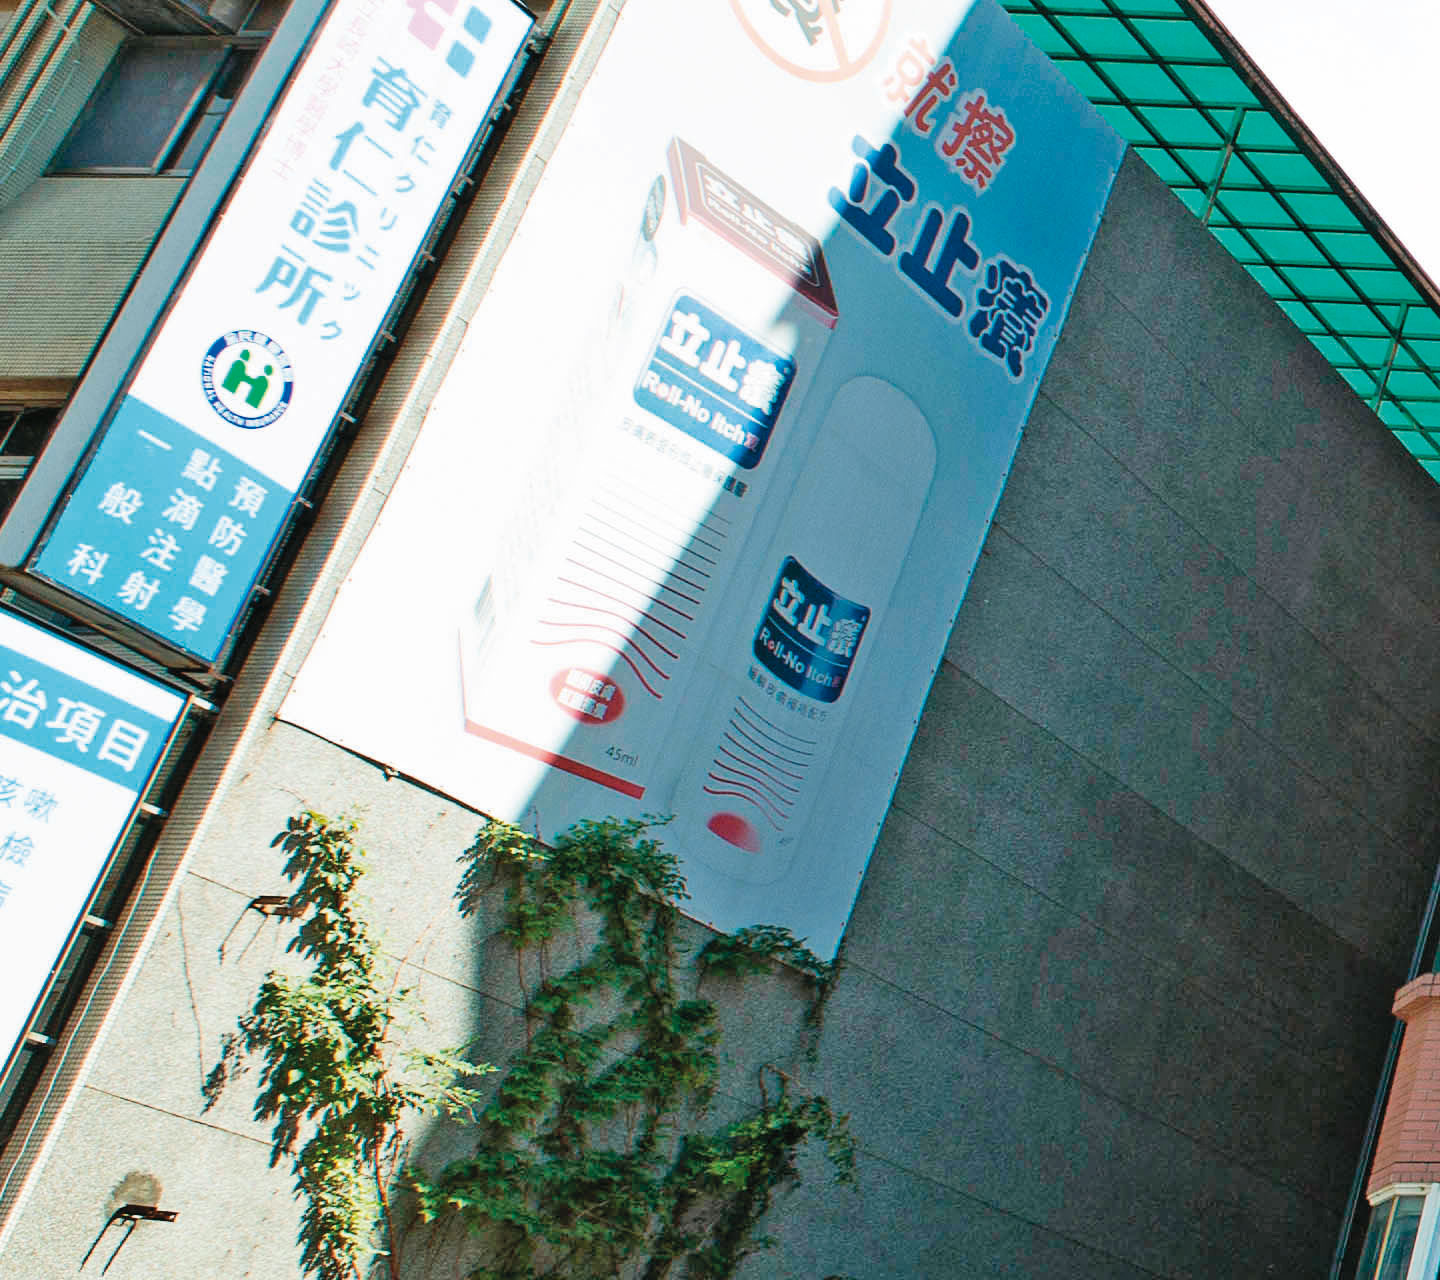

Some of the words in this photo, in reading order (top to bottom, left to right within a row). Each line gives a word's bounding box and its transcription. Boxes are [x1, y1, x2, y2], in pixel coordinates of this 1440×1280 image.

[252, 56, 428, 327] 育仁診所
[320, 98, 455, 340] 育仁クリニック
[830, 136, 1048, 378] 立止癢
[641, 370, 711, 427] Roll-No
[710, 407, 746, 446] Itch
[660, 310, 787, 414] 立止癢
[67, 429, 172, 586] 一般科
[119, 447, 225, 613] 點滴注射
[172, 475, 269, 634] 預防醫學
[0, 670, 149, 772] 治項目
